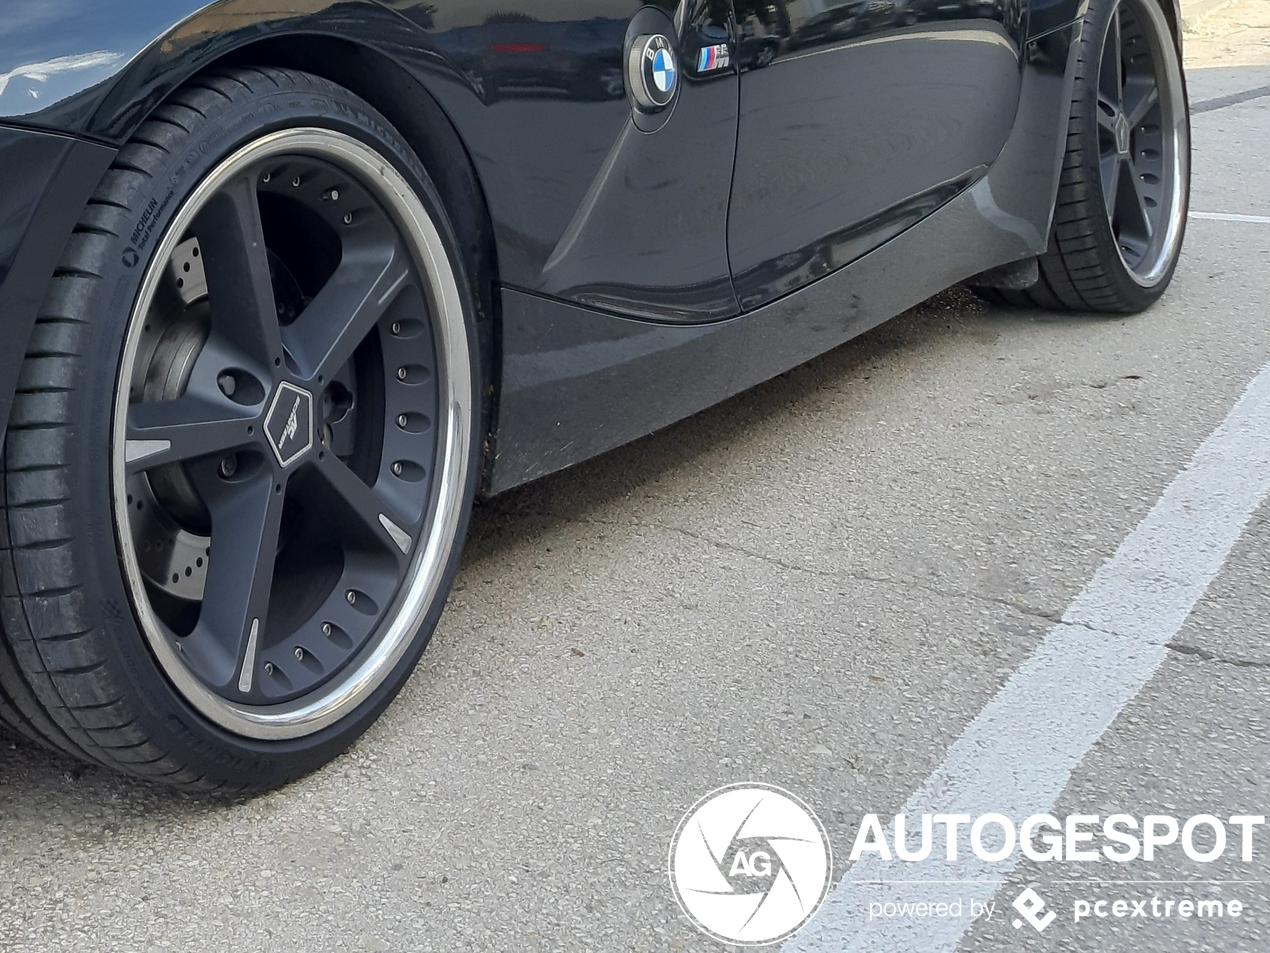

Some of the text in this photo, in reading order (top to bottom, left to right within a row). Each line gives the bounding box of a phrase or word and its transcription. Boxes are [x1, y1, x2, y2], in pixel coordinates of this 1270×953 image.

[130, 197, 158, 244] MICHELIN
[138, 190, 175, 251] Total Performance
